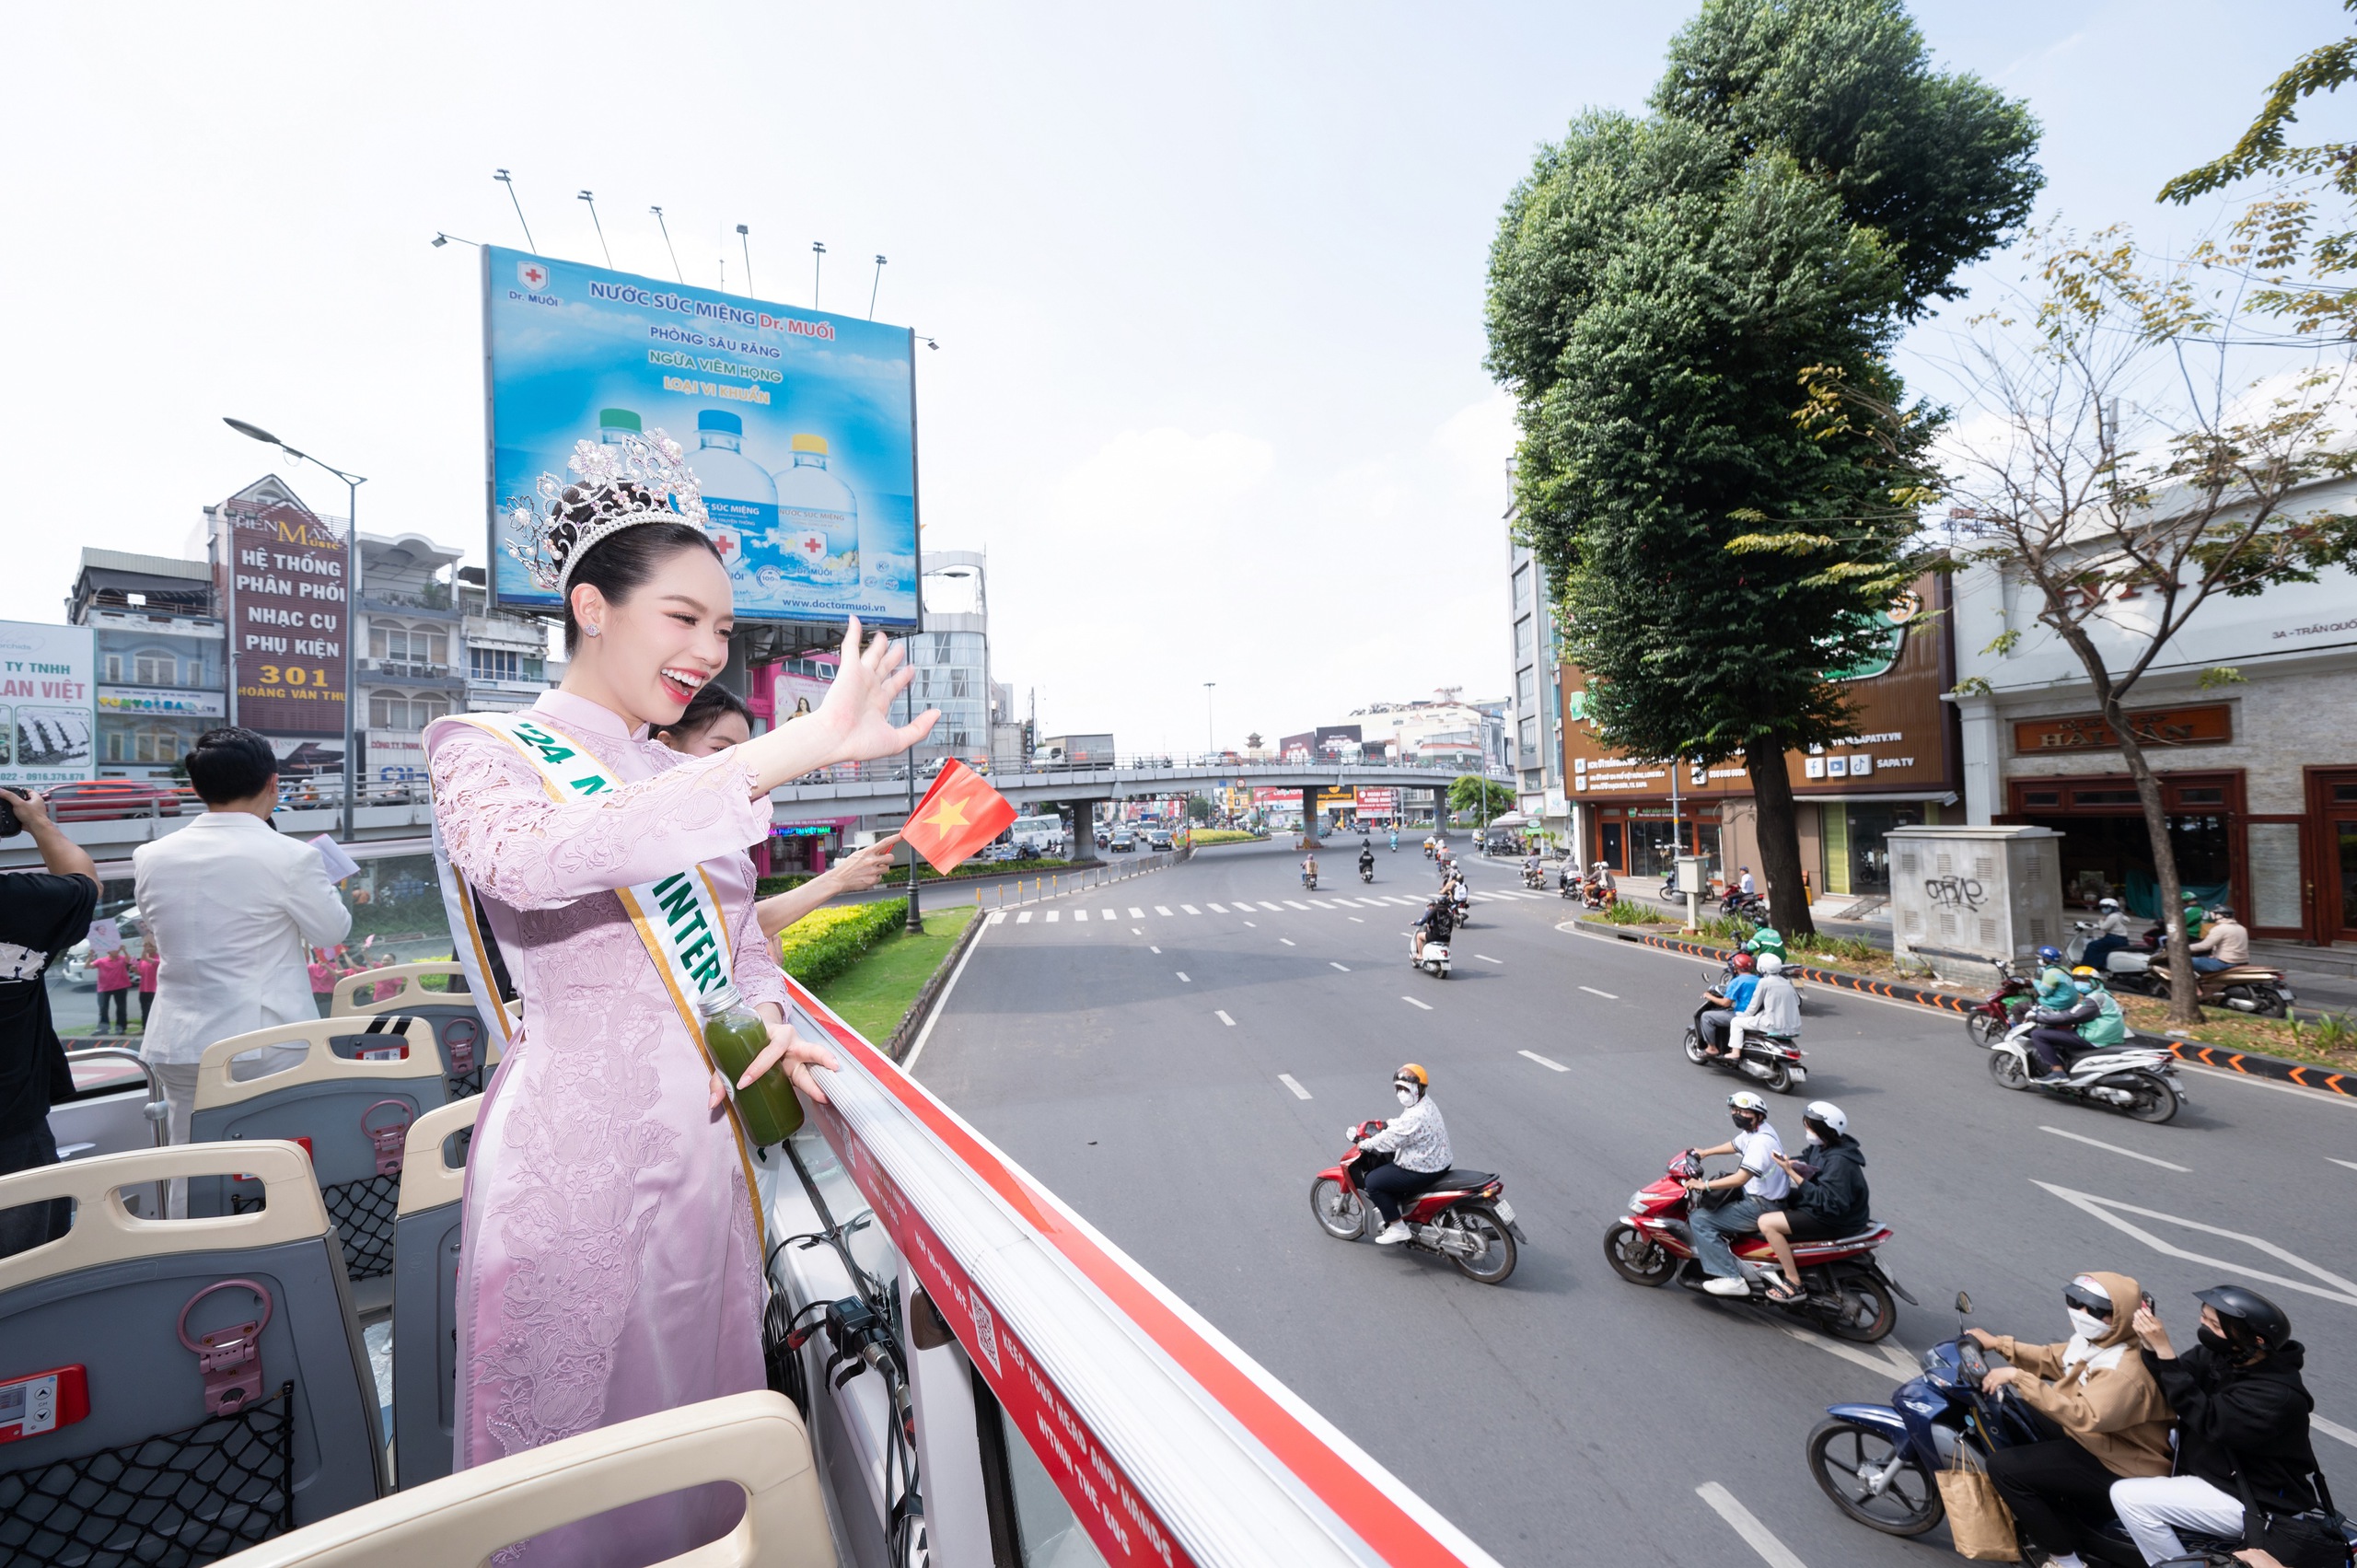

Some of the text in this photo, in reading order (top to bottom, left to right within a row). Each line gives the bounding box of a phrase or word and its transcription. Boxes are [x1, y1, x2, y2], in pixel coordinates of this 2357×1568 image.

[509, 291, 559, 307] Dr. MUỐI
[589, 282, 834, 340] NƯỚC SÚC MIỆNG Dr. MUỐI
[650, 327, 781, 358] PHÒNG SÂU RĂNG
[649, 351, 782, 382] NGỪA VIÊM HỌNG
[664, 377, 771, 404] LOẠI VI KHUẨN
[712, 503, 728, 512] SÚC
[731, 505, 760, 516] MIỆNG
[241, 547, 342, 577] HỆ THỐNG
[237, 575, 345, 602] PHÂN PHỐI
[783, 599, 886, 612] www.doctormuoi.vn
[249, 607, 337, 633] NHẠC CỤ
[246, 634, 339, 659] PHỤ KIỆN
[2272, 631, 2287, 639] 3A
[5, 661, 71, 675] TY TNHH
[259, 665, 328, 688] 301
[41, 679, 86, 703] VIỆT
[238, 685, 346, 704] HOÀNG VĂN THỤ
[1876, 758, 1901, 768] SAPA
[1901, 758, 1914, 766] TV
[652, 871, 728, 995] INTER
[1001, 1329, 1174, 1568] KEEP YOUR HEAD AND HANDS
[1037, 1410, 1132, 1556] WITHIN THE BUS
